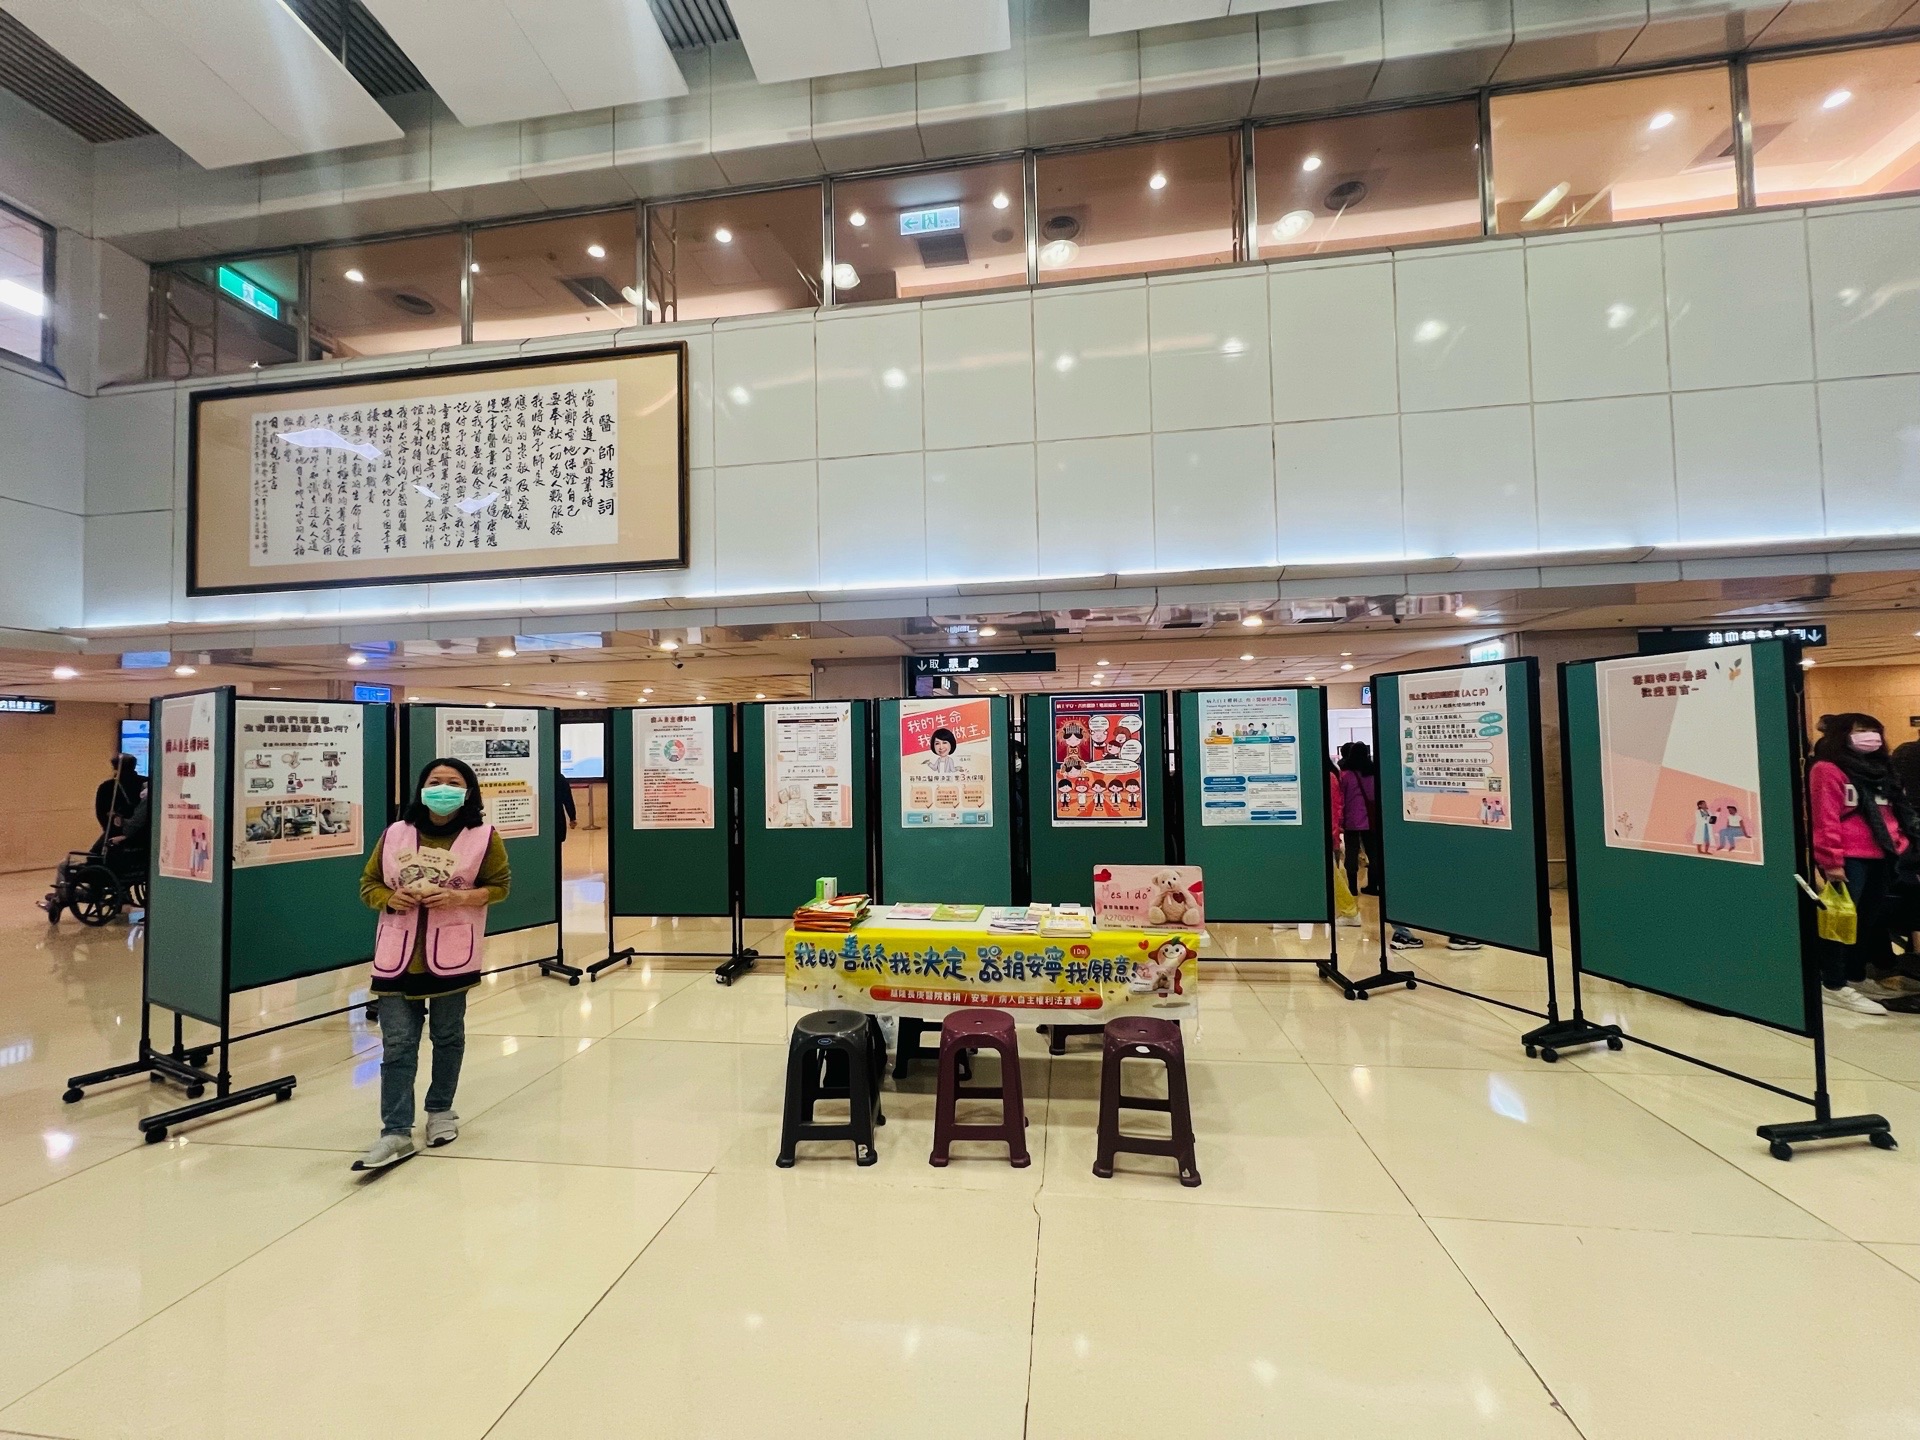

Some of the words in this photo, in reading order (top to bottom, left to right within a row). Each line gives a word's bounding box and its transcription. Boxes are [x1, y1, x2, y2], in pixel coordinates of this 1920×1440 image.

[530, 392, 546, 487] 我將給予師長
[563, 389, 580, 518] 我鄭重地保證自己
[581, 388, 597, 508] 當我進入醫業時
[597, 414, 615, 516] 醫師誓詞
[907, 710, 962, 734] 我的生命
[917, 723, 985, 748] 我做主。
